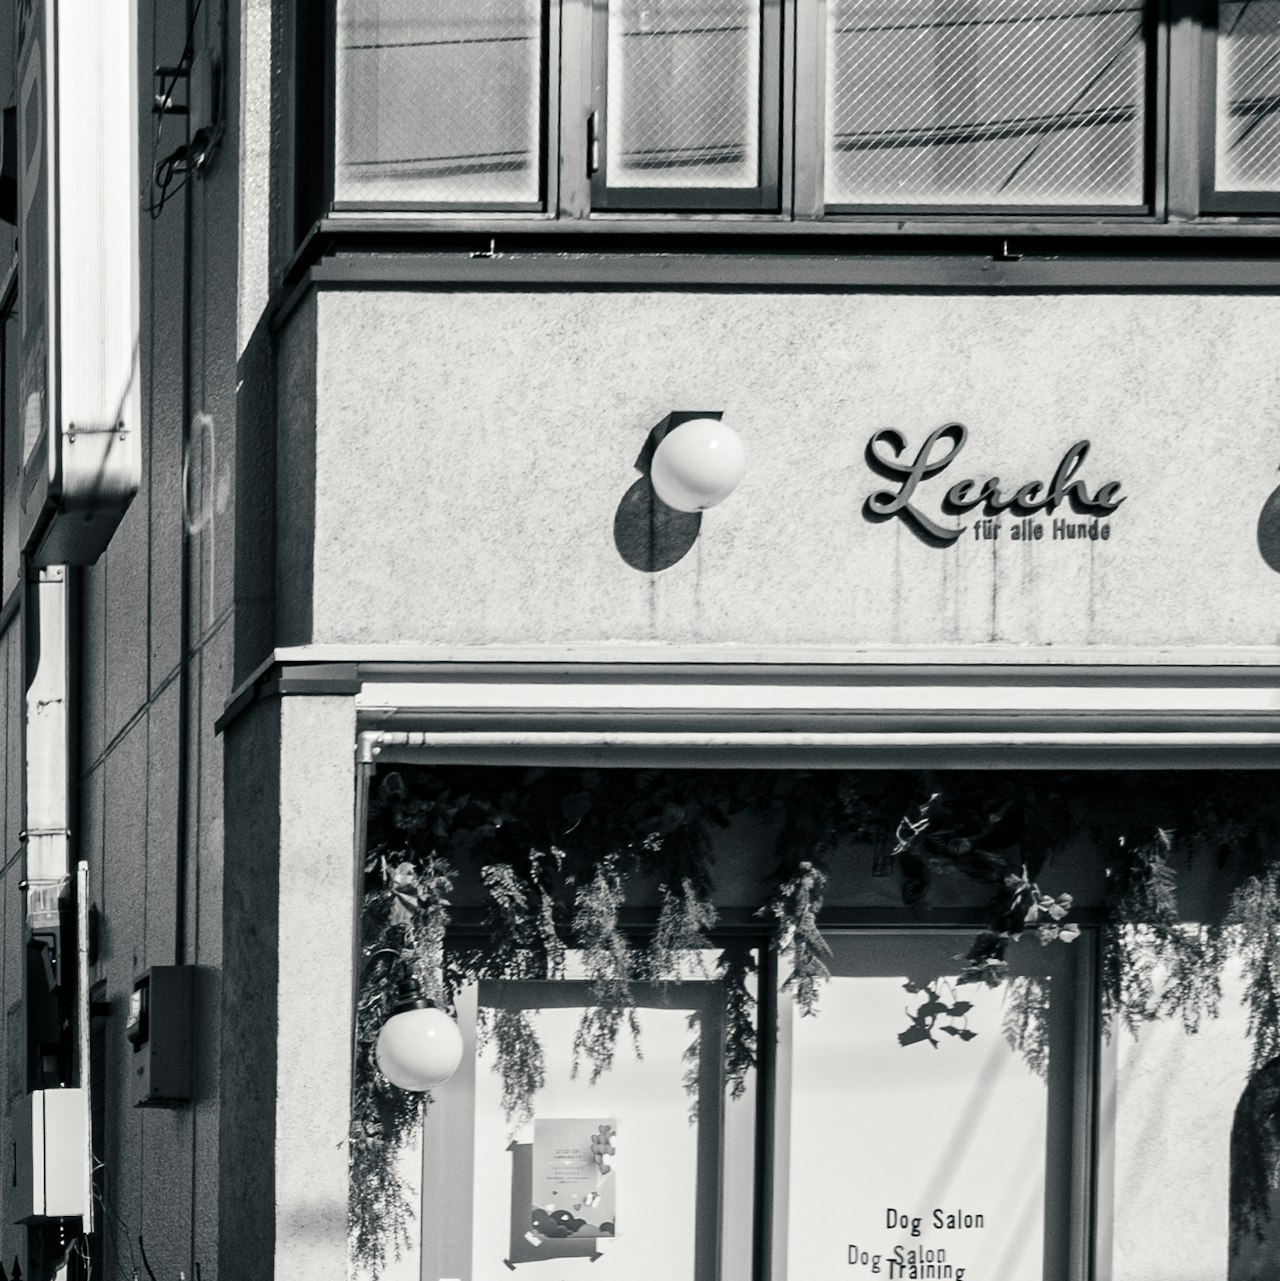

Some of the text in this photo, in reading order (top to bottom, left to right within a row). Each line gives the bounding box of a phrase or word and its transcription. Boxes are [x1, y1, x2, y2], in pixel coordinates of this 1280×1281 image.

[862, 421, 1128, 549] Lerche
[974, 519, 1111, 541] für alle Hunde
[886, 1208, 985, 1237] Dog Salon
[847, 1244, 947, 1274] Dog Salon
